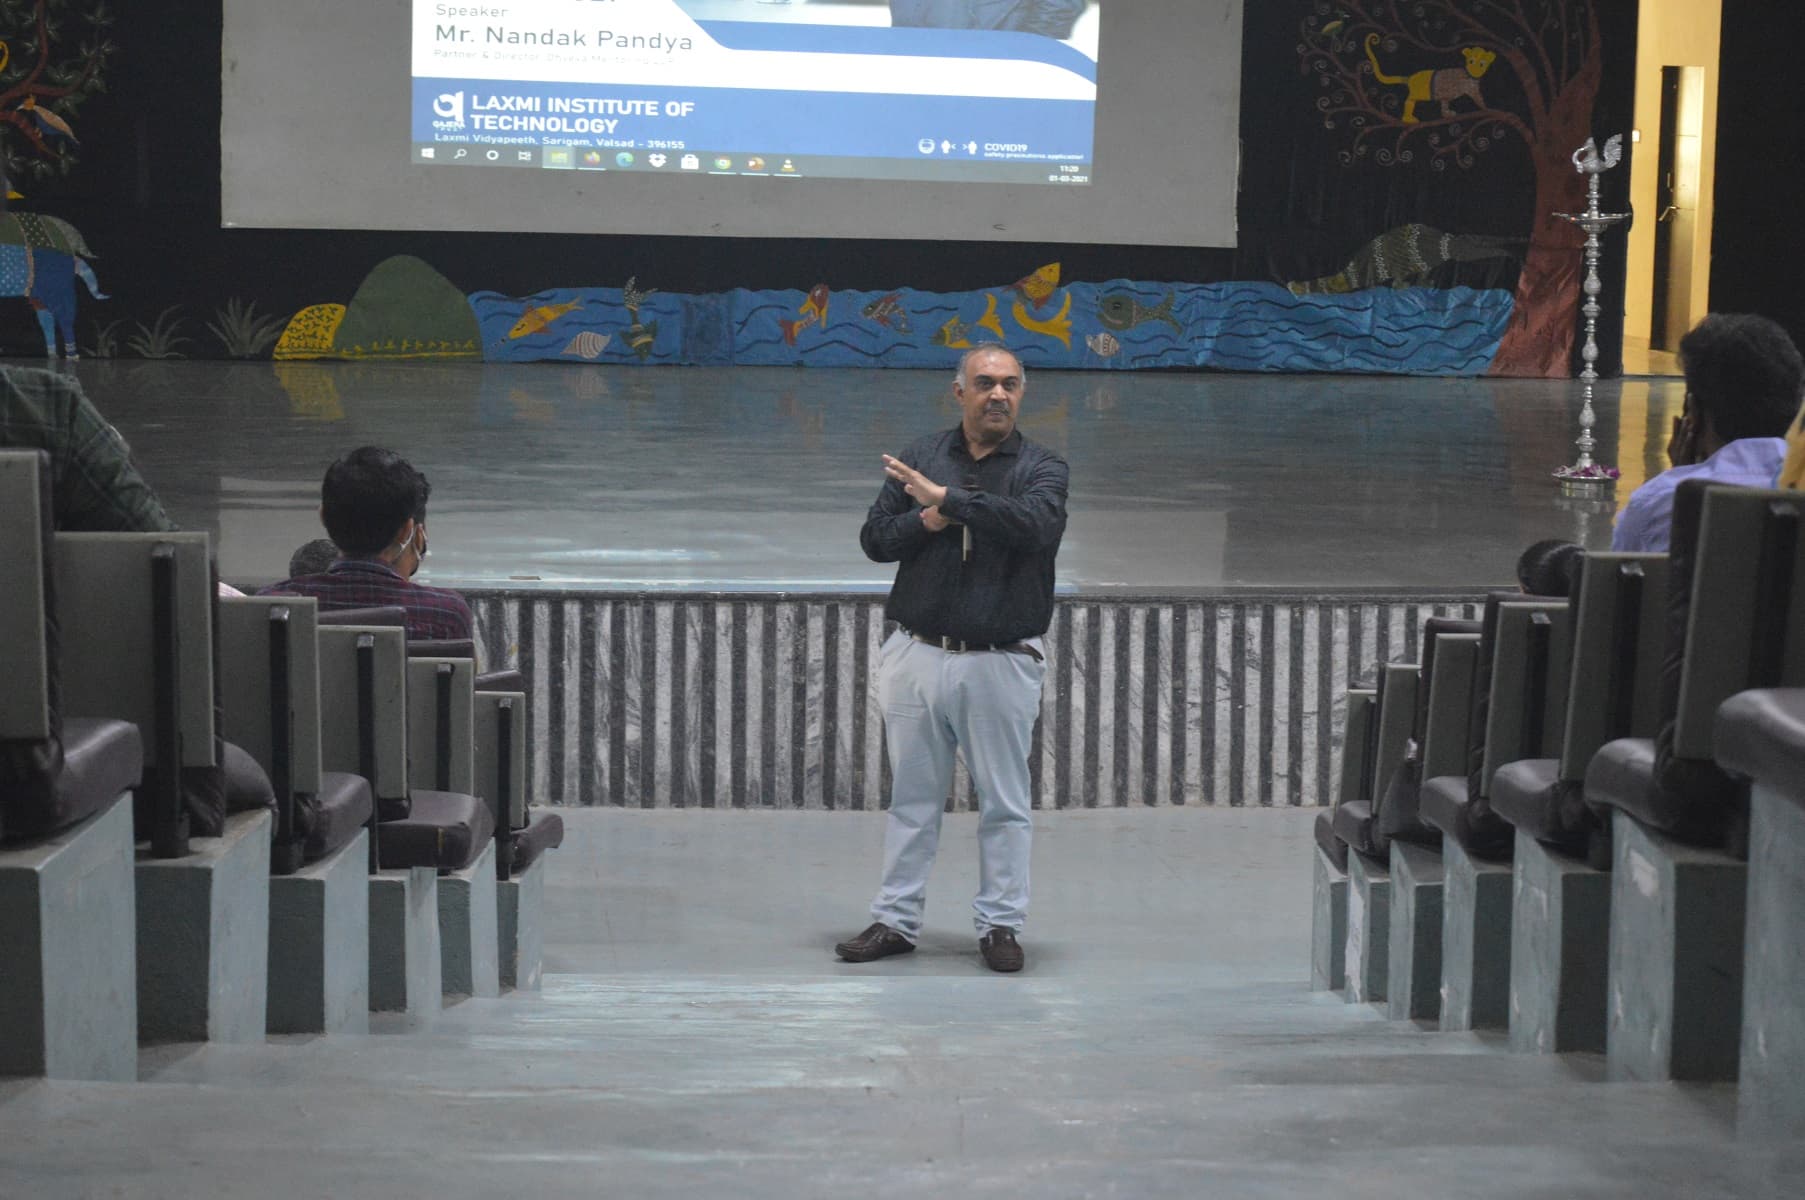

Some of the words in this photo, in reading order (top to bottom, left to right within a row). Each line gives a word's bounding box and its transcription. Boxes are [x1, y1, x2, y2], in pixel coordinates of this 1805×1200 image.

[435, 3, 509, 19] Speaker
[435, 24, 475, 43] Mr.
[485, 27, 587, 47] Nandak
[597, 30, 693, 54] Pandya
[433, 49, 478, 59] Partner
[494, 52, 540, 62] Director
[472, 95, 541, 112] LAXMI
[547, 98, 659, 116] INSTITUTE
[665, 101, 695, 117] OF
[470, 114, 619, 134] TECHNOLOGY
[434, 133, 470, 143] Laxmi
[596, 138, 635, 148] Valsad
[647, 140, 686, 149] 396155
[984, 143, 1028, 152] COVID19
